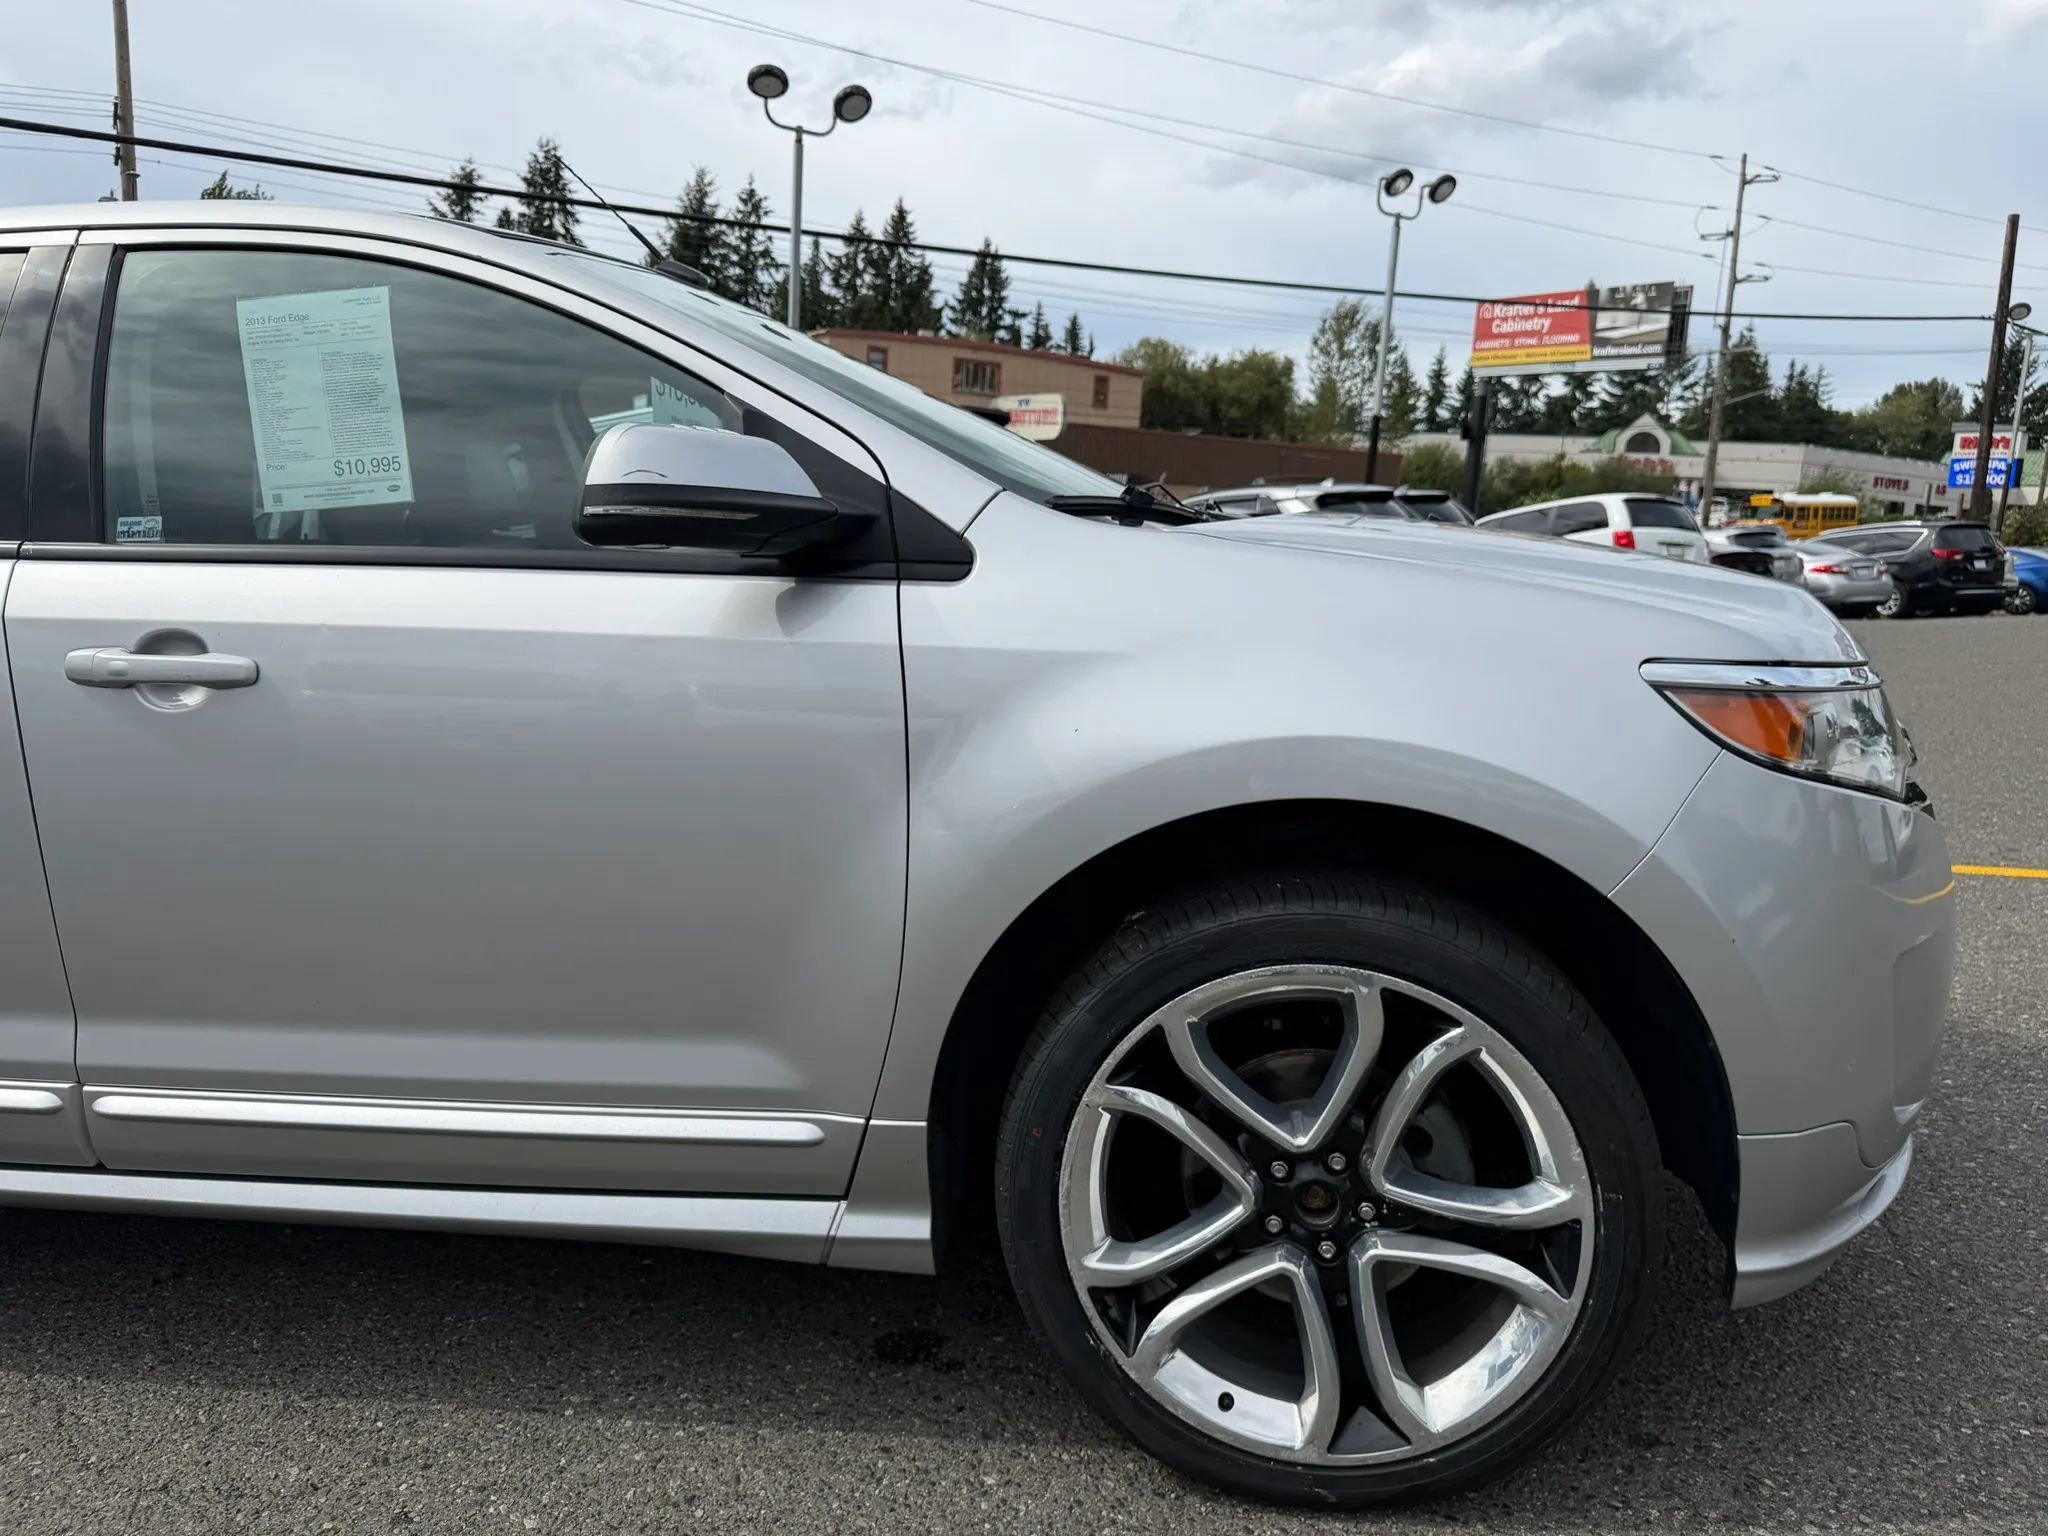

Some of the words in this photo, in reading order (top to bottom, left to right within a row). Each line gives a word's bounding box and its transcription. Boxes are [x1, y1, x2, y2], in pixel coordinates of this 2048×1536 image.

[245, 316, 266, 326] 2013
[267, 314, 286, 324] Ford
[288, 313, 310, 323] Edge
[1491, 316, 1552, 334] Cabinetry
[266, 463, 288, 471] Price:
[333, 455, 402, 478] $10,995
[1873, 476, 1910, 492] STOVES
